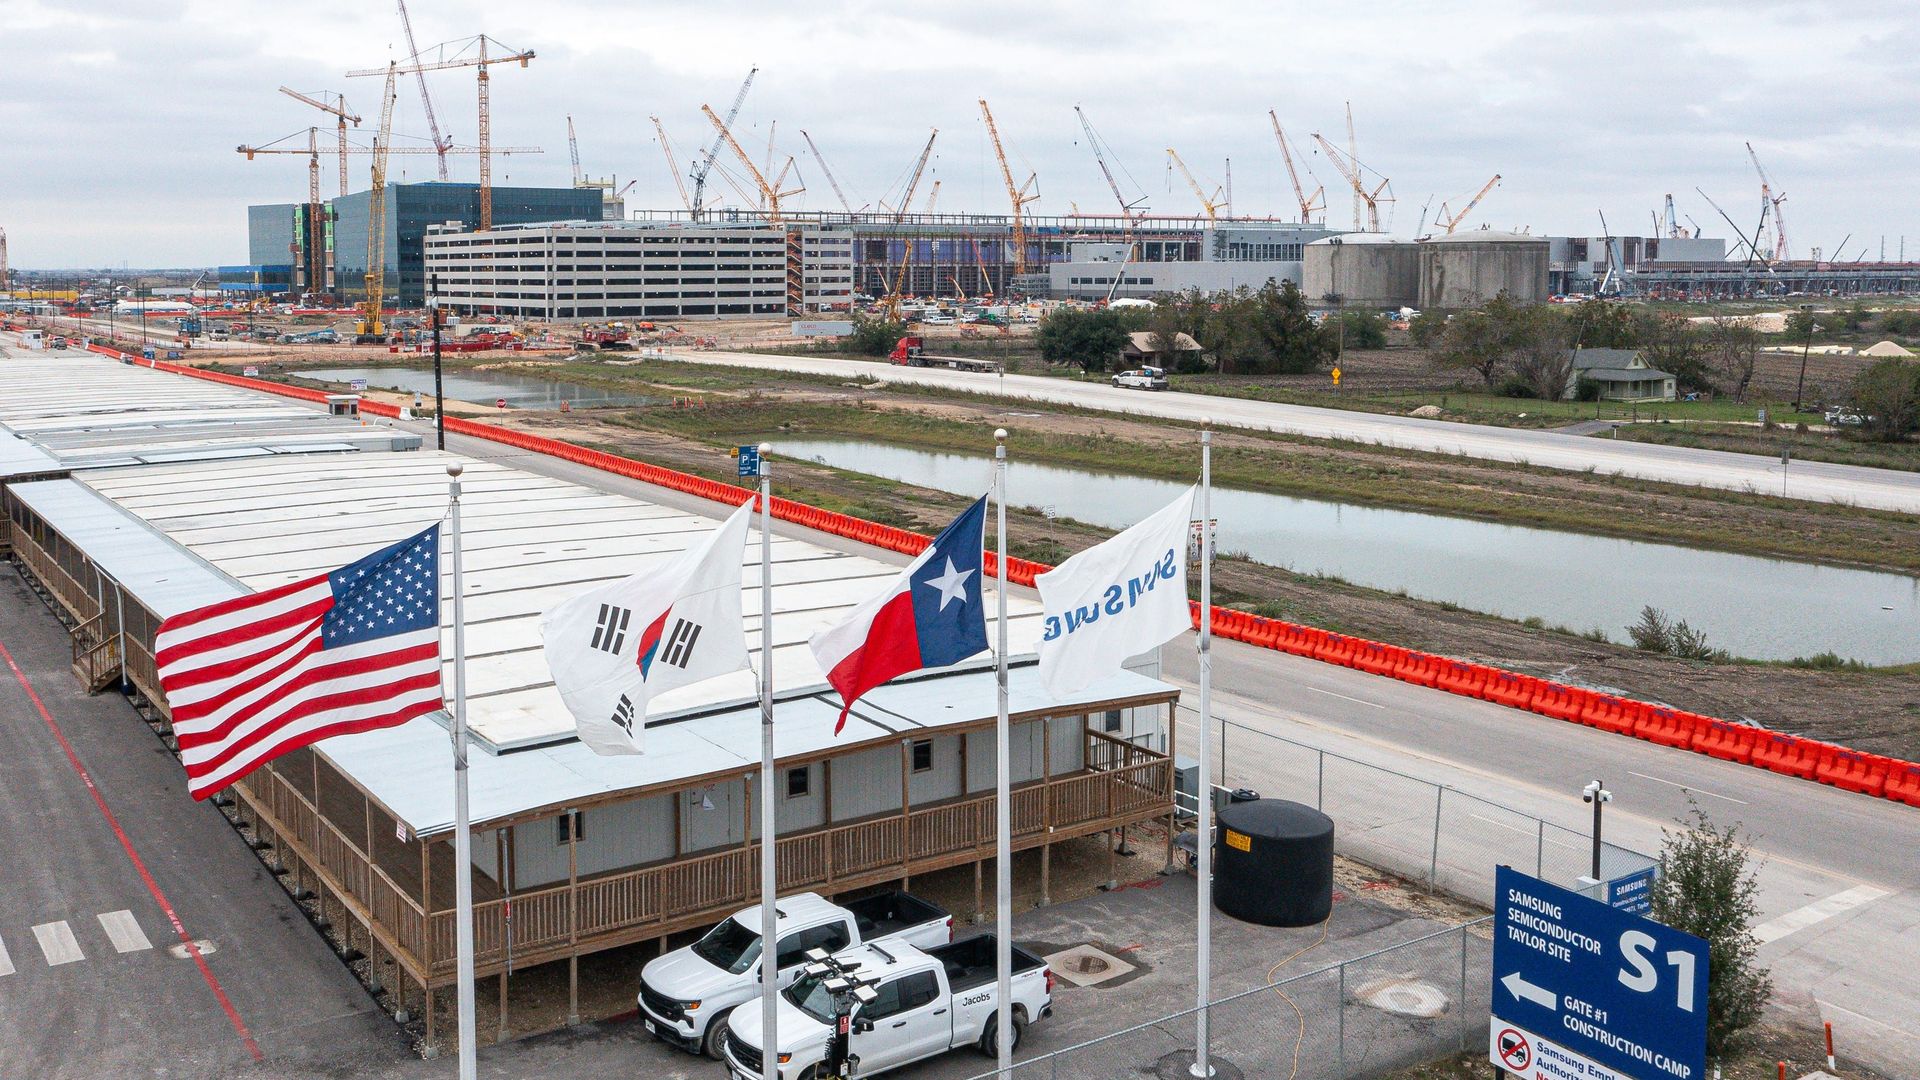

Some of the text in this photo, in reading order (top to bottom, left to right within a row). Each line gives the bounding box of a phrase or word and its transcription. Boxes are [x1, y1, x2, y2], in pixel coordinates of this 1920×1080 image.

[742, 455, 748, 463] P
[1612, 896, 1638, 908] Construction
[1616, 879, 1647, 896] SAMSUNG
[1508, 888, 1562, 920] SAMSUNG
[1507, 925, 1571, 963] TAYLOR SITE
[1508, 907, 1601, 956] SEMICONDUCTOR
[1617, 930, 1695, 1013] S1
[962, 993, 991, 1007] Jacobs
[1564, 995, 1607, 1025] GATE #1
[1536, 1041, 1585, 1074] Samsung
[1563, 1014, 1691, 1080] CONSTRUCTION CAMP
